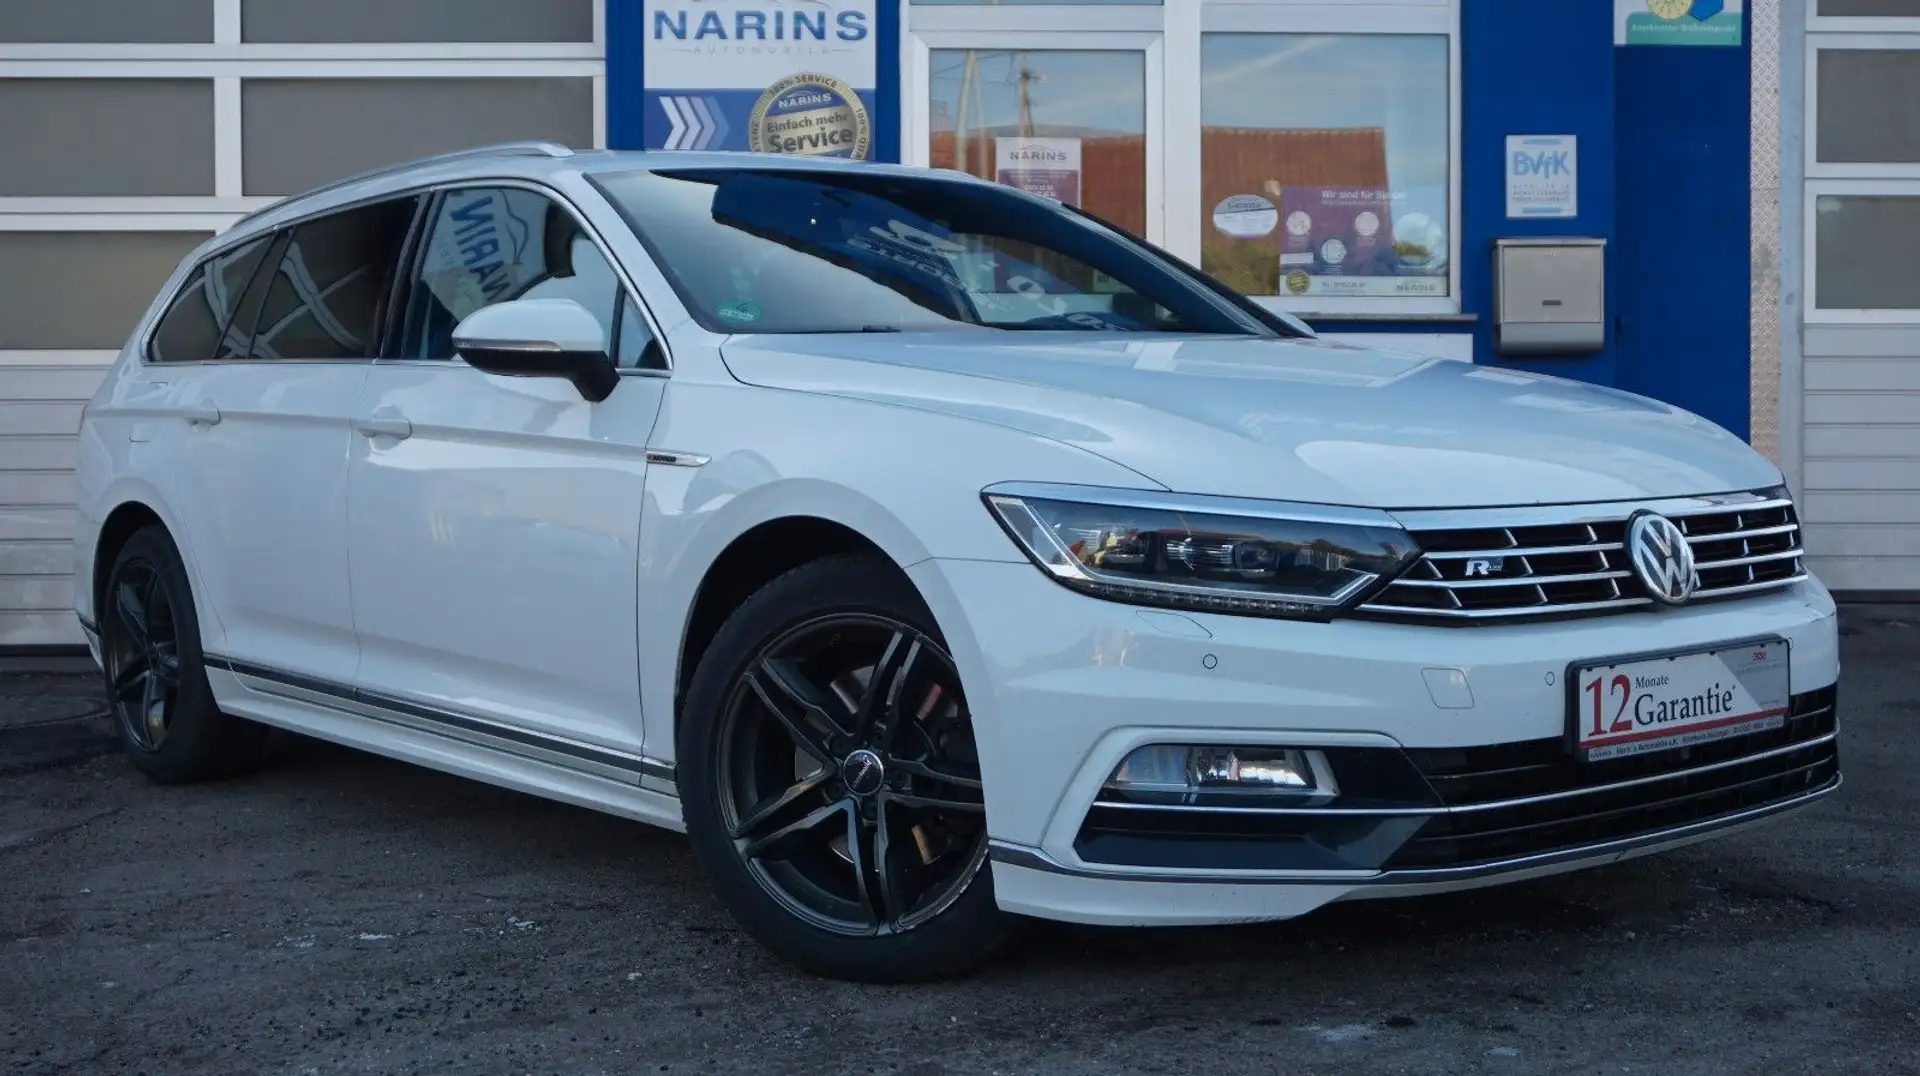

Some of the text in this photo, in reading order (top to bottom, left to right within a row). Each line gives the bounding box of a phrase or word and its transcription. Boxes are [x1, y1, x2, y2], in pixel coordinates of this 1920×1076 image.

[653, 10, 868, 41] NARINS
[795, 74, 838, 88] SERVICE
[778, 92, 832, 109] NARINS
[766, 112, 848, 133] Einfach mehr
[767, 126, 853, 154] Service
[1009, 150, 1067, 161] NARINS
[1635, 675, 1669, 689] Monate
[1584, 674, 1633, 738] 12
